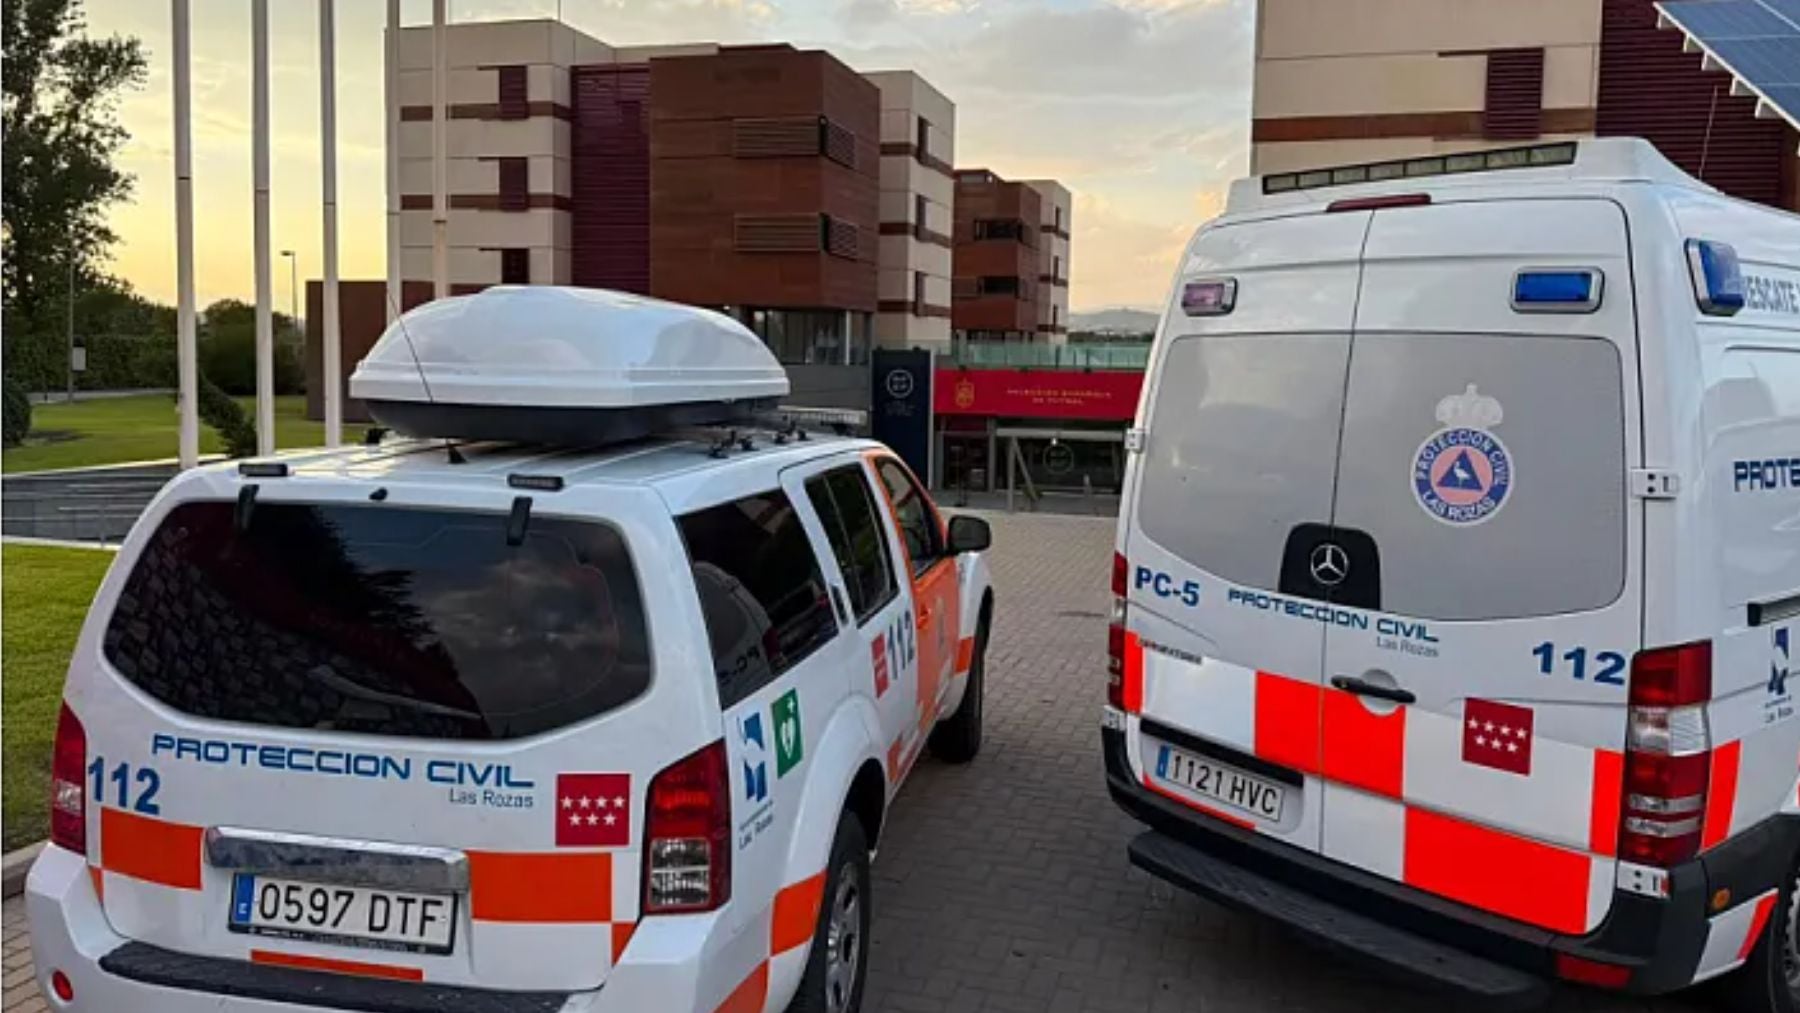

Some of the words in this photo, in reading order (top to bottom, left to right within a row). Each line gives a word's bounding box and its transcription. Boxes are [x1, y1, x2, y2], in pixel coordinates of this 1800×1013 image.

[1135, 566, 1200, 607] PC-5
[1228, 588, 1368, 630] PROTECCION
[1377, 618, 1440, 643] CIVIL
[887, 610, 915, 681] 112
[1376, 636, 1398, 651] Las
[1400, 639, 1439, 658] Rozas
[1532, 641, 1626, 685] 112
[88, 756, 161, 816] 112
[152, 733, 411, 780] PROTECCION
[427, 760, 535, 788] CIVIL
[1173, 755, 1222, 795] 1121
[1229, 775, 1277, 815] HVC
[449, 787, 477, 806] Las
[482, 789, 534, 809] Rozas
[259, 883, 355, 929] 0597
[368, 894, 443, 937] DTF
